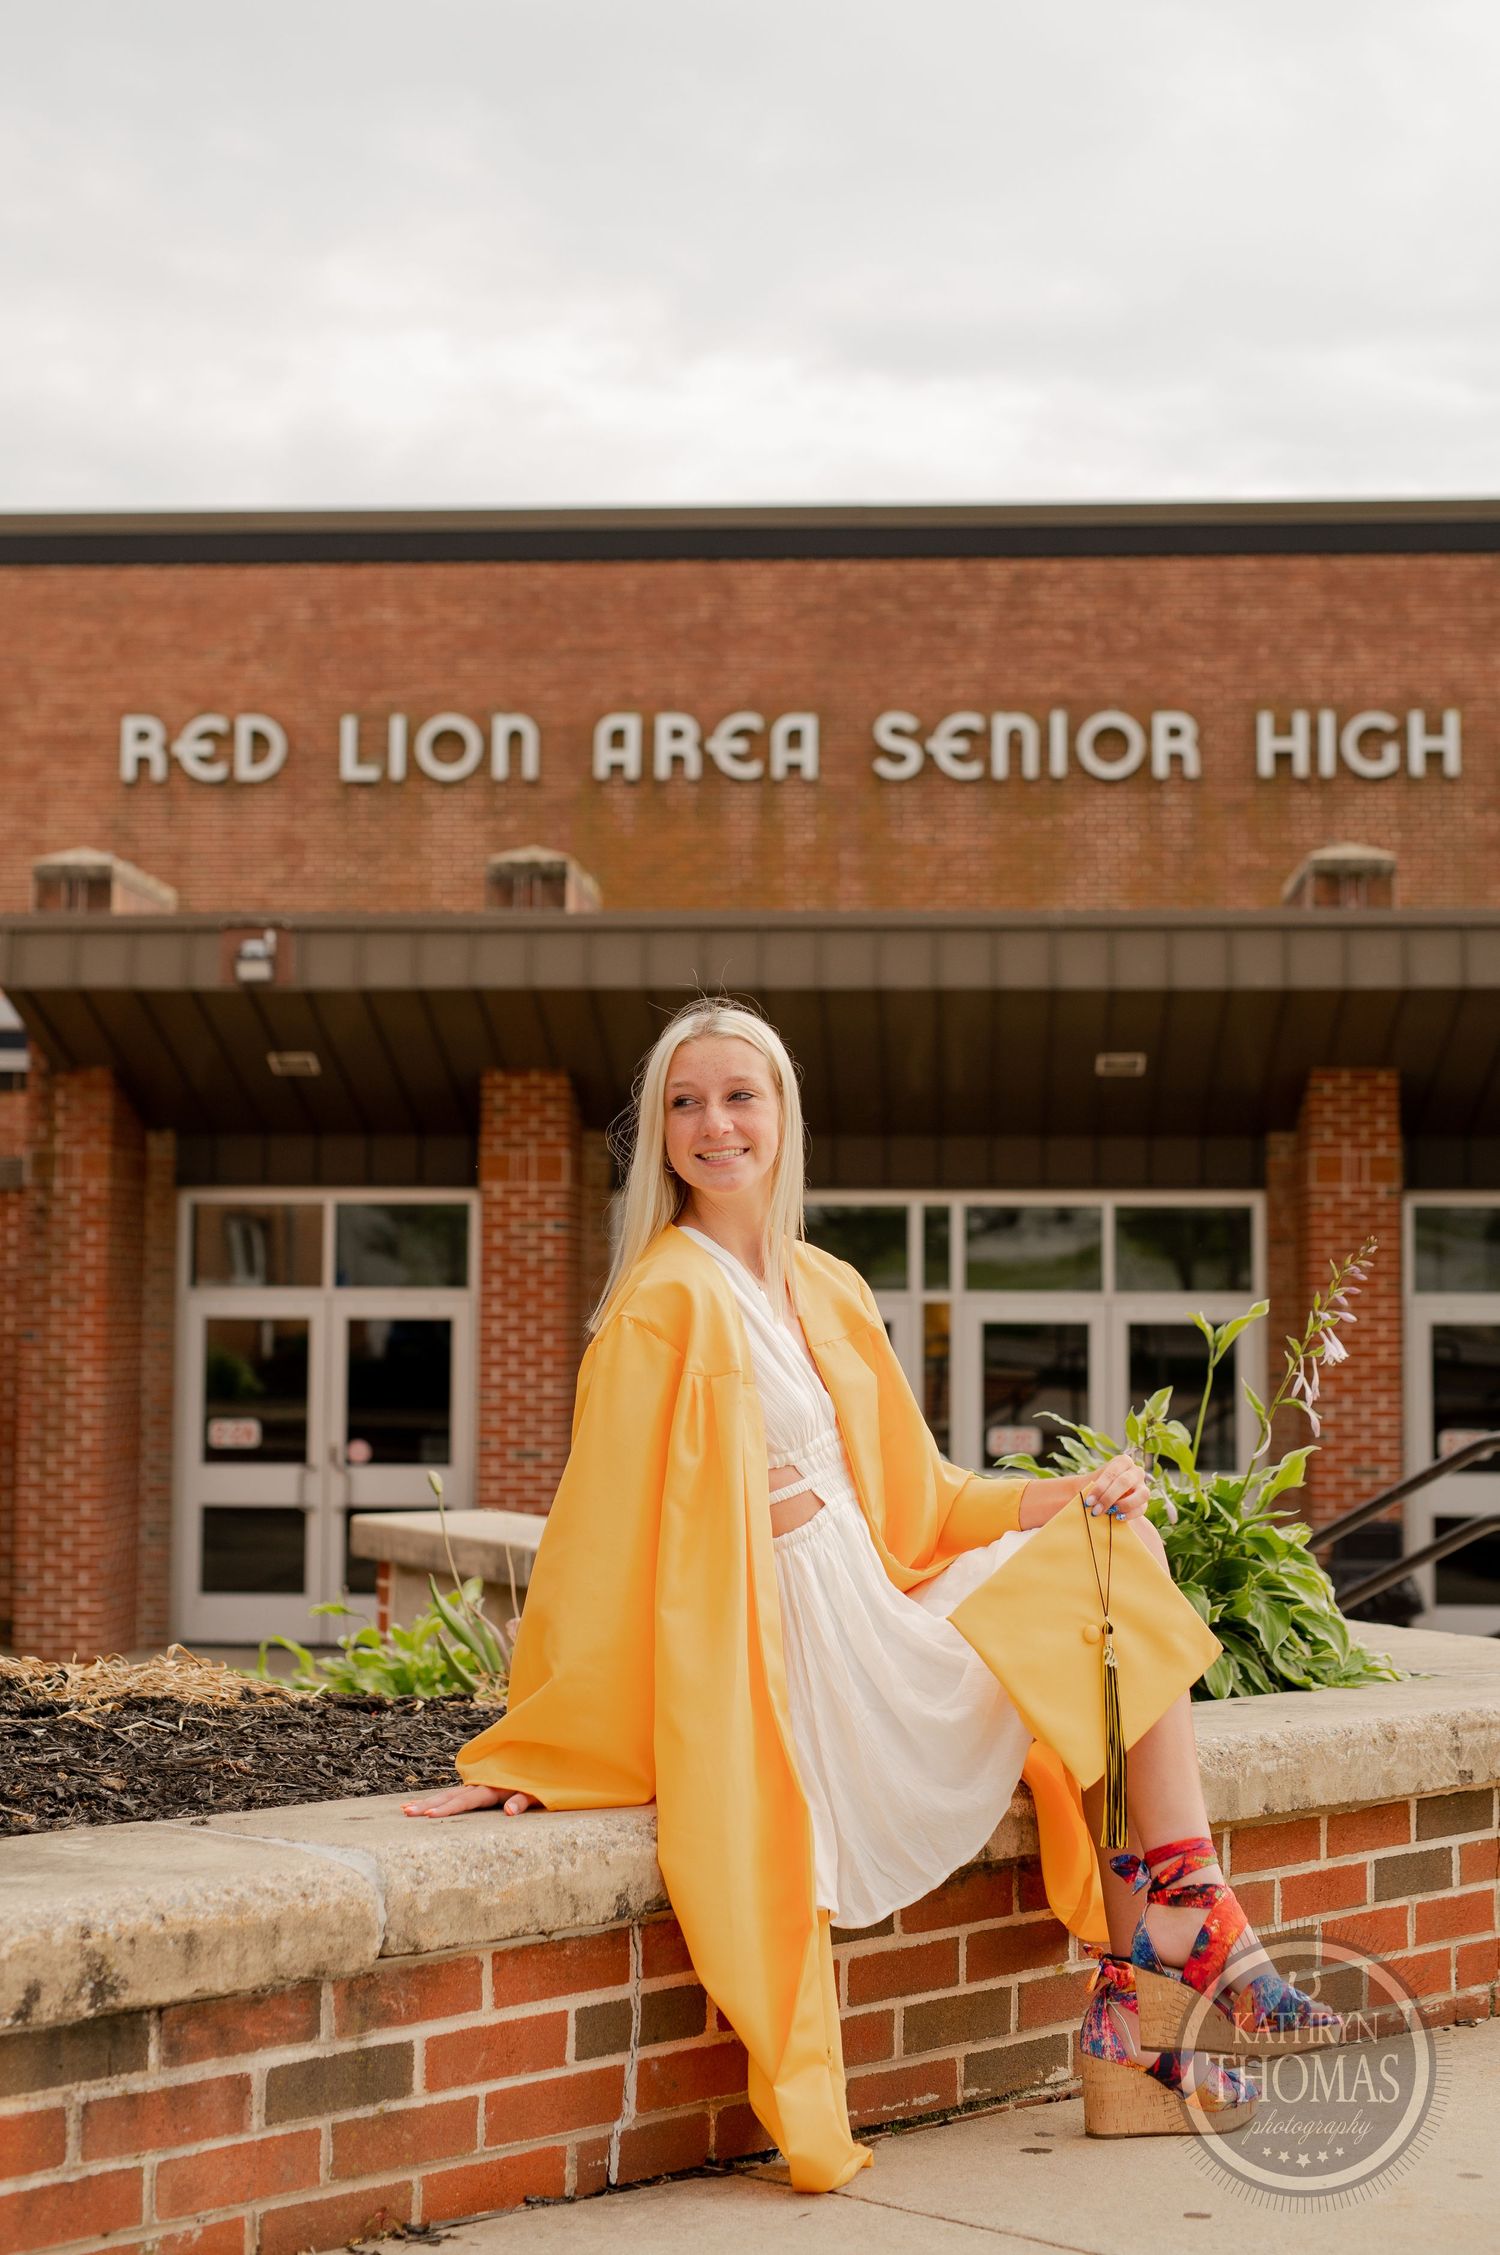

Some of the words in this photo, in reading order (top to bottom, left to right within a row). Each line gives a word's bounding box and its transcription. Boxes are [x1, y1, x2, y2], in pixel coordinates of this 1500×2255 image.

[119, 713, 289, 784] RED
[338, 713, 541, 784] LION
[592, 711, 820, 783] AREA
[872, 709, 1201, 782] SENIOR
[1255, 709, 1463, 780] HIGH
